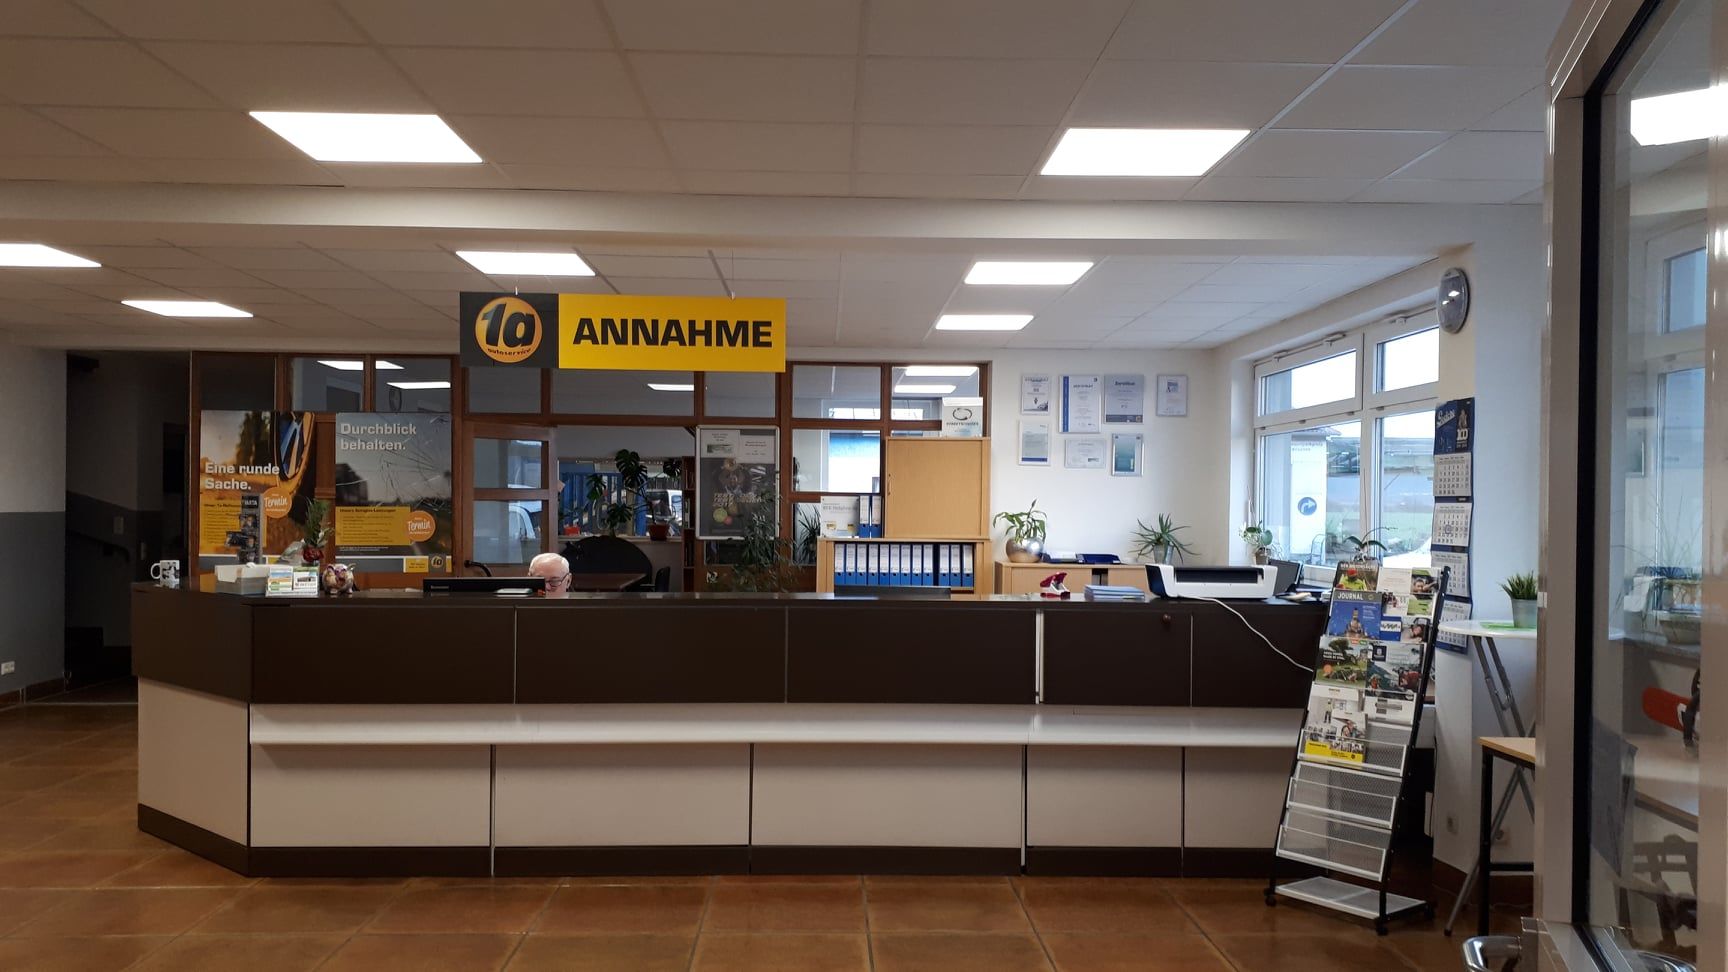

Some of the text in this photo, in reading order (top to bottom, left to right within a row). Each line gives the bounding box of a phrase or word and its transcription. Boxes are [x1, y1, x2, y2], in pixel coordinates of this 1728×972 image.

[481, 303, 536, 348] 1a
[573, 317, 773, 348] ANNAHME
[340, 423, 417, 435] Durchblick
[340, 438, 406, 450] behalten.
[204, 463, 280, 475] Eine runde
[204, 478, 252, 490] Sache.
[264, 496, 288, 508] Termin
[407, 519, 431, 532] Termin
[1337, 592, 1364, 601] JOURNAL
